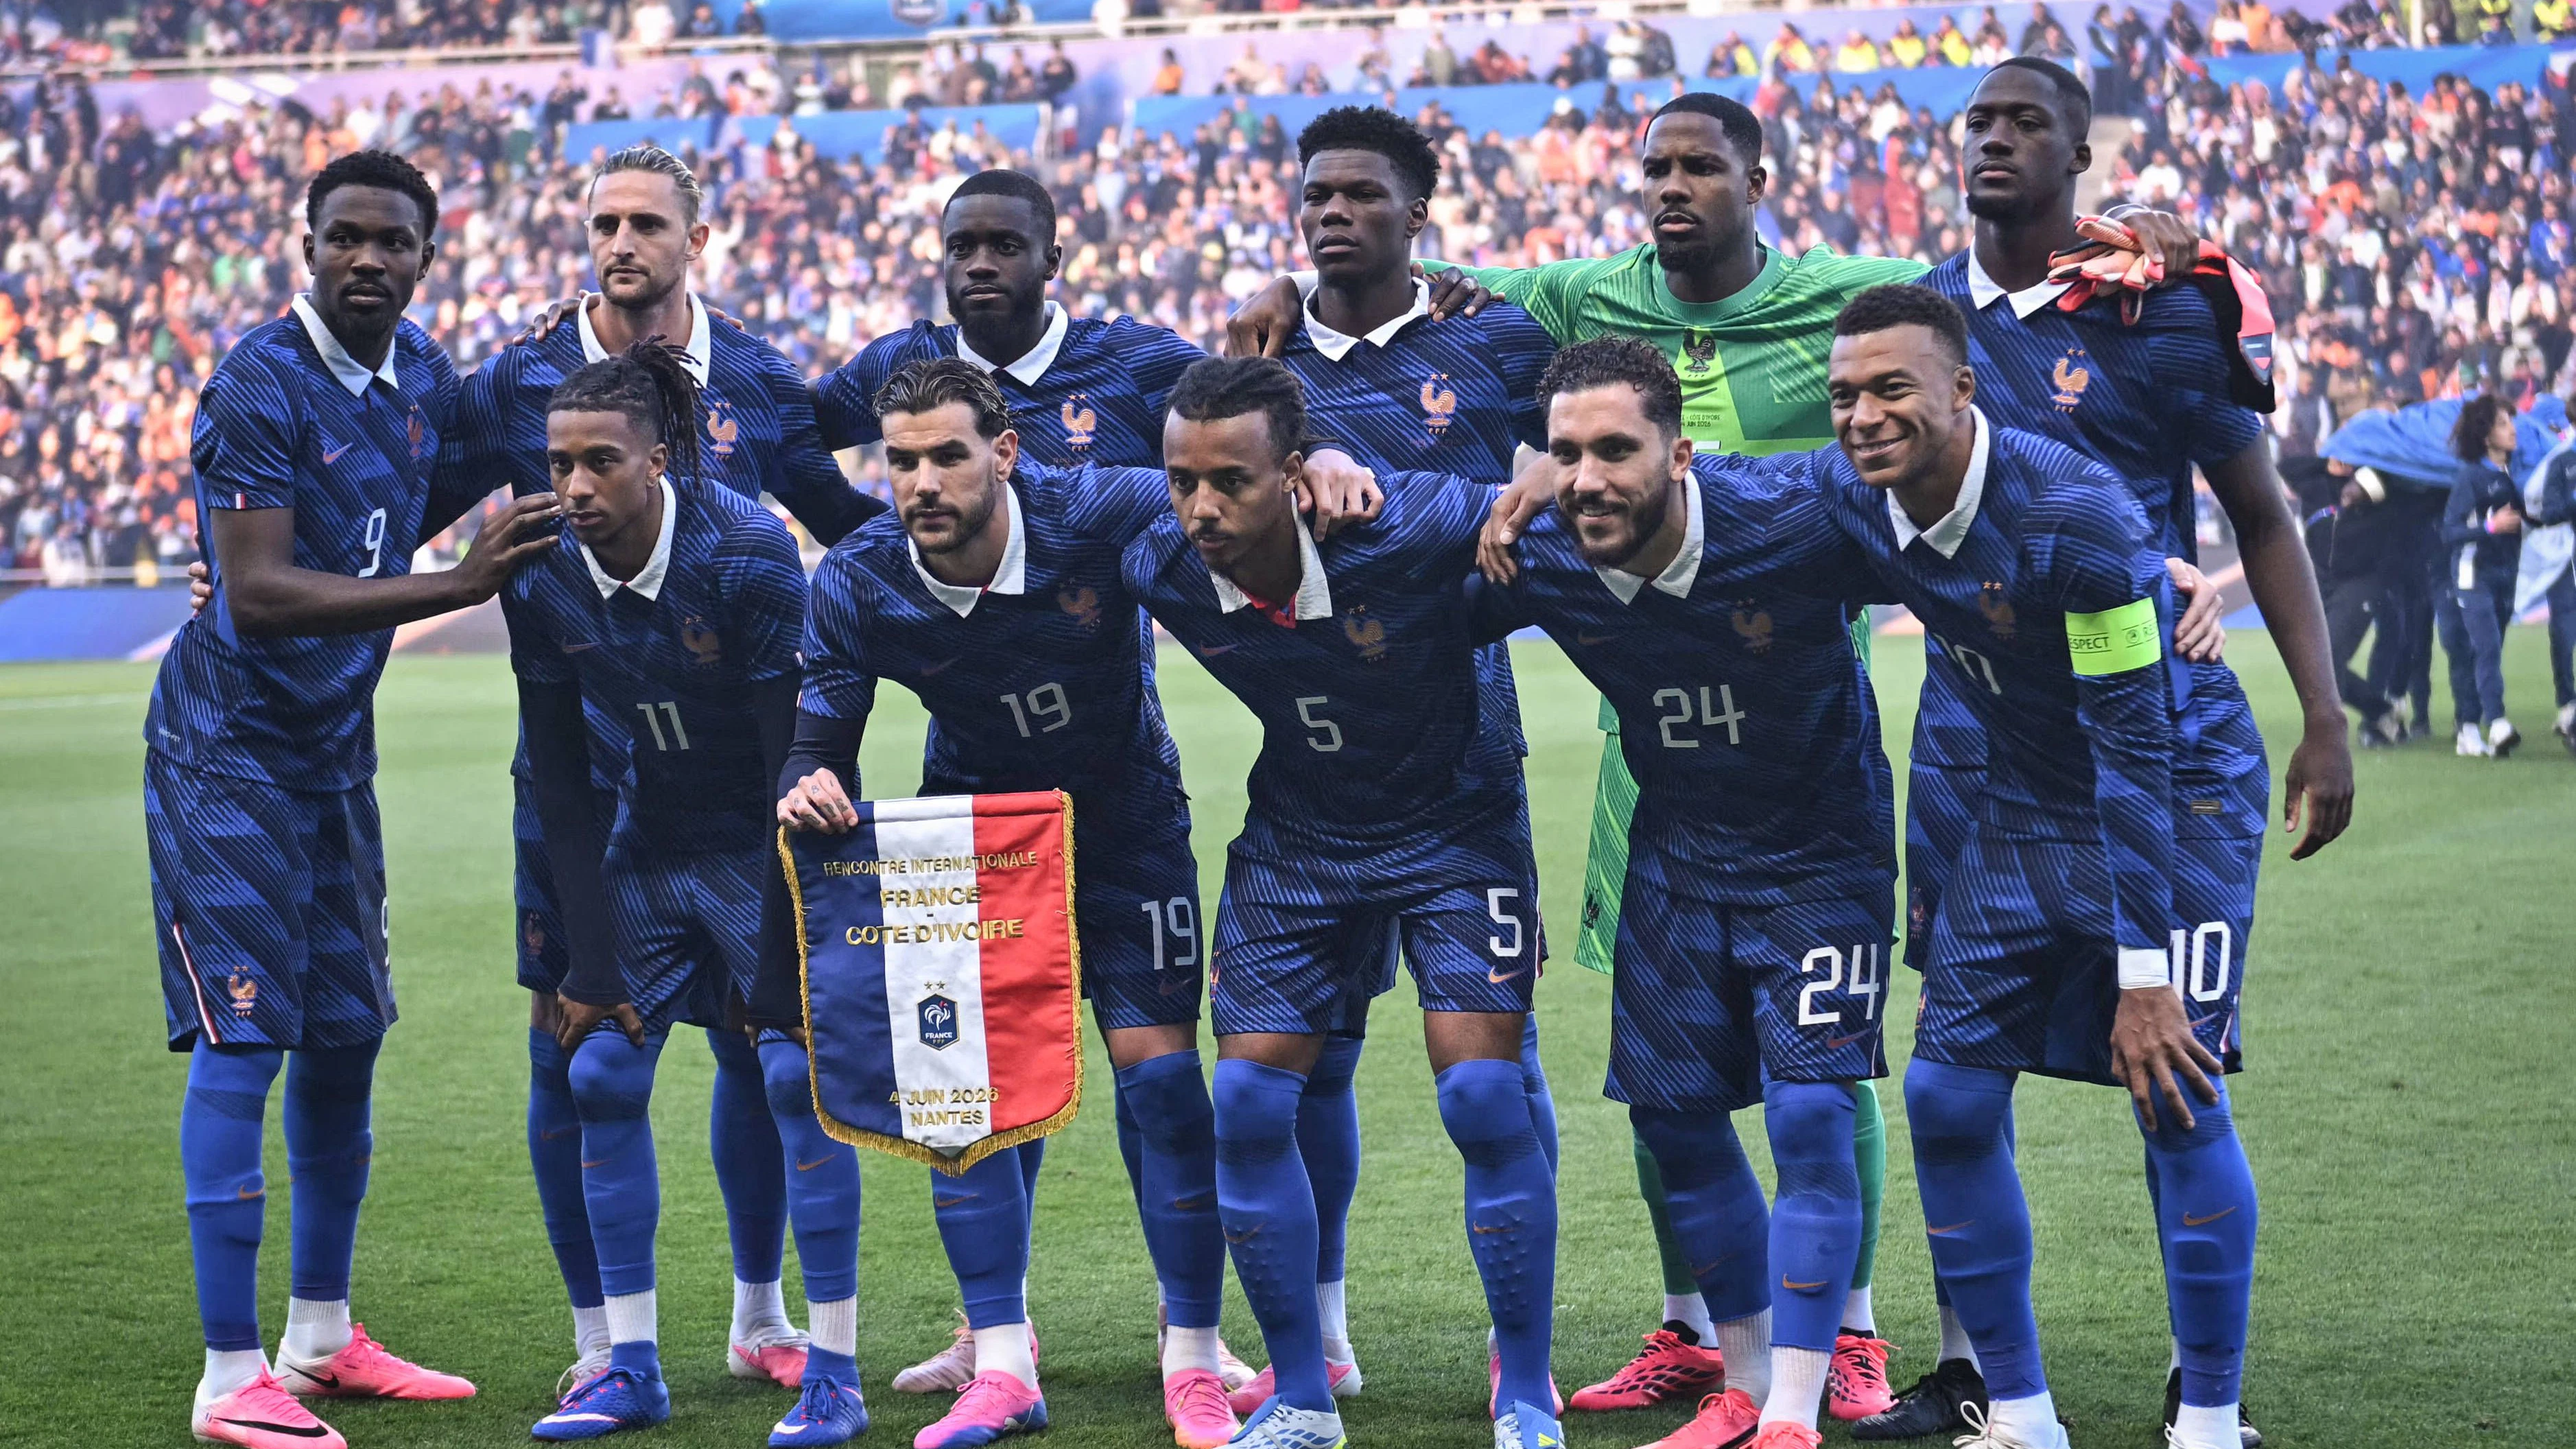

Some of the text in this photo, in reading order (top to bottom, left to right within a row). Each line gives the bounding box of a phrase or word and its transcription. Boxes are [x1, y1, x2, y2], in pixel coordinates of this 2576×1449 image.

[358, 508, 386, 578] 9
[2069, 637, 2109, 649] ESPECT
[636, 701, 689, 751] 11
[1000, 682, 1072, 738] 19
[1295, 696, 1343, 752] 5
[1653, 684, 1746, 748] 24
[824, 851, 1037, 876] RENCONTRE INTERNATIONALE
[880, 885, 982, 908] FRANCE
[1487, 888, 1522, 957] 5
[845, 919, 1024, 945] COTE D'IVOIRE
[1141, 897, 1197, 970] 19
[1797, 943, 1880, 1026] 24
[2169, 921, 2231, 1002] 10
[925, 1031, 953, 1039] FRANCE
[889, 1087, 1000, 1106] 4 JUIN 2026
[911, 1111, 984, 1126] NANTES
